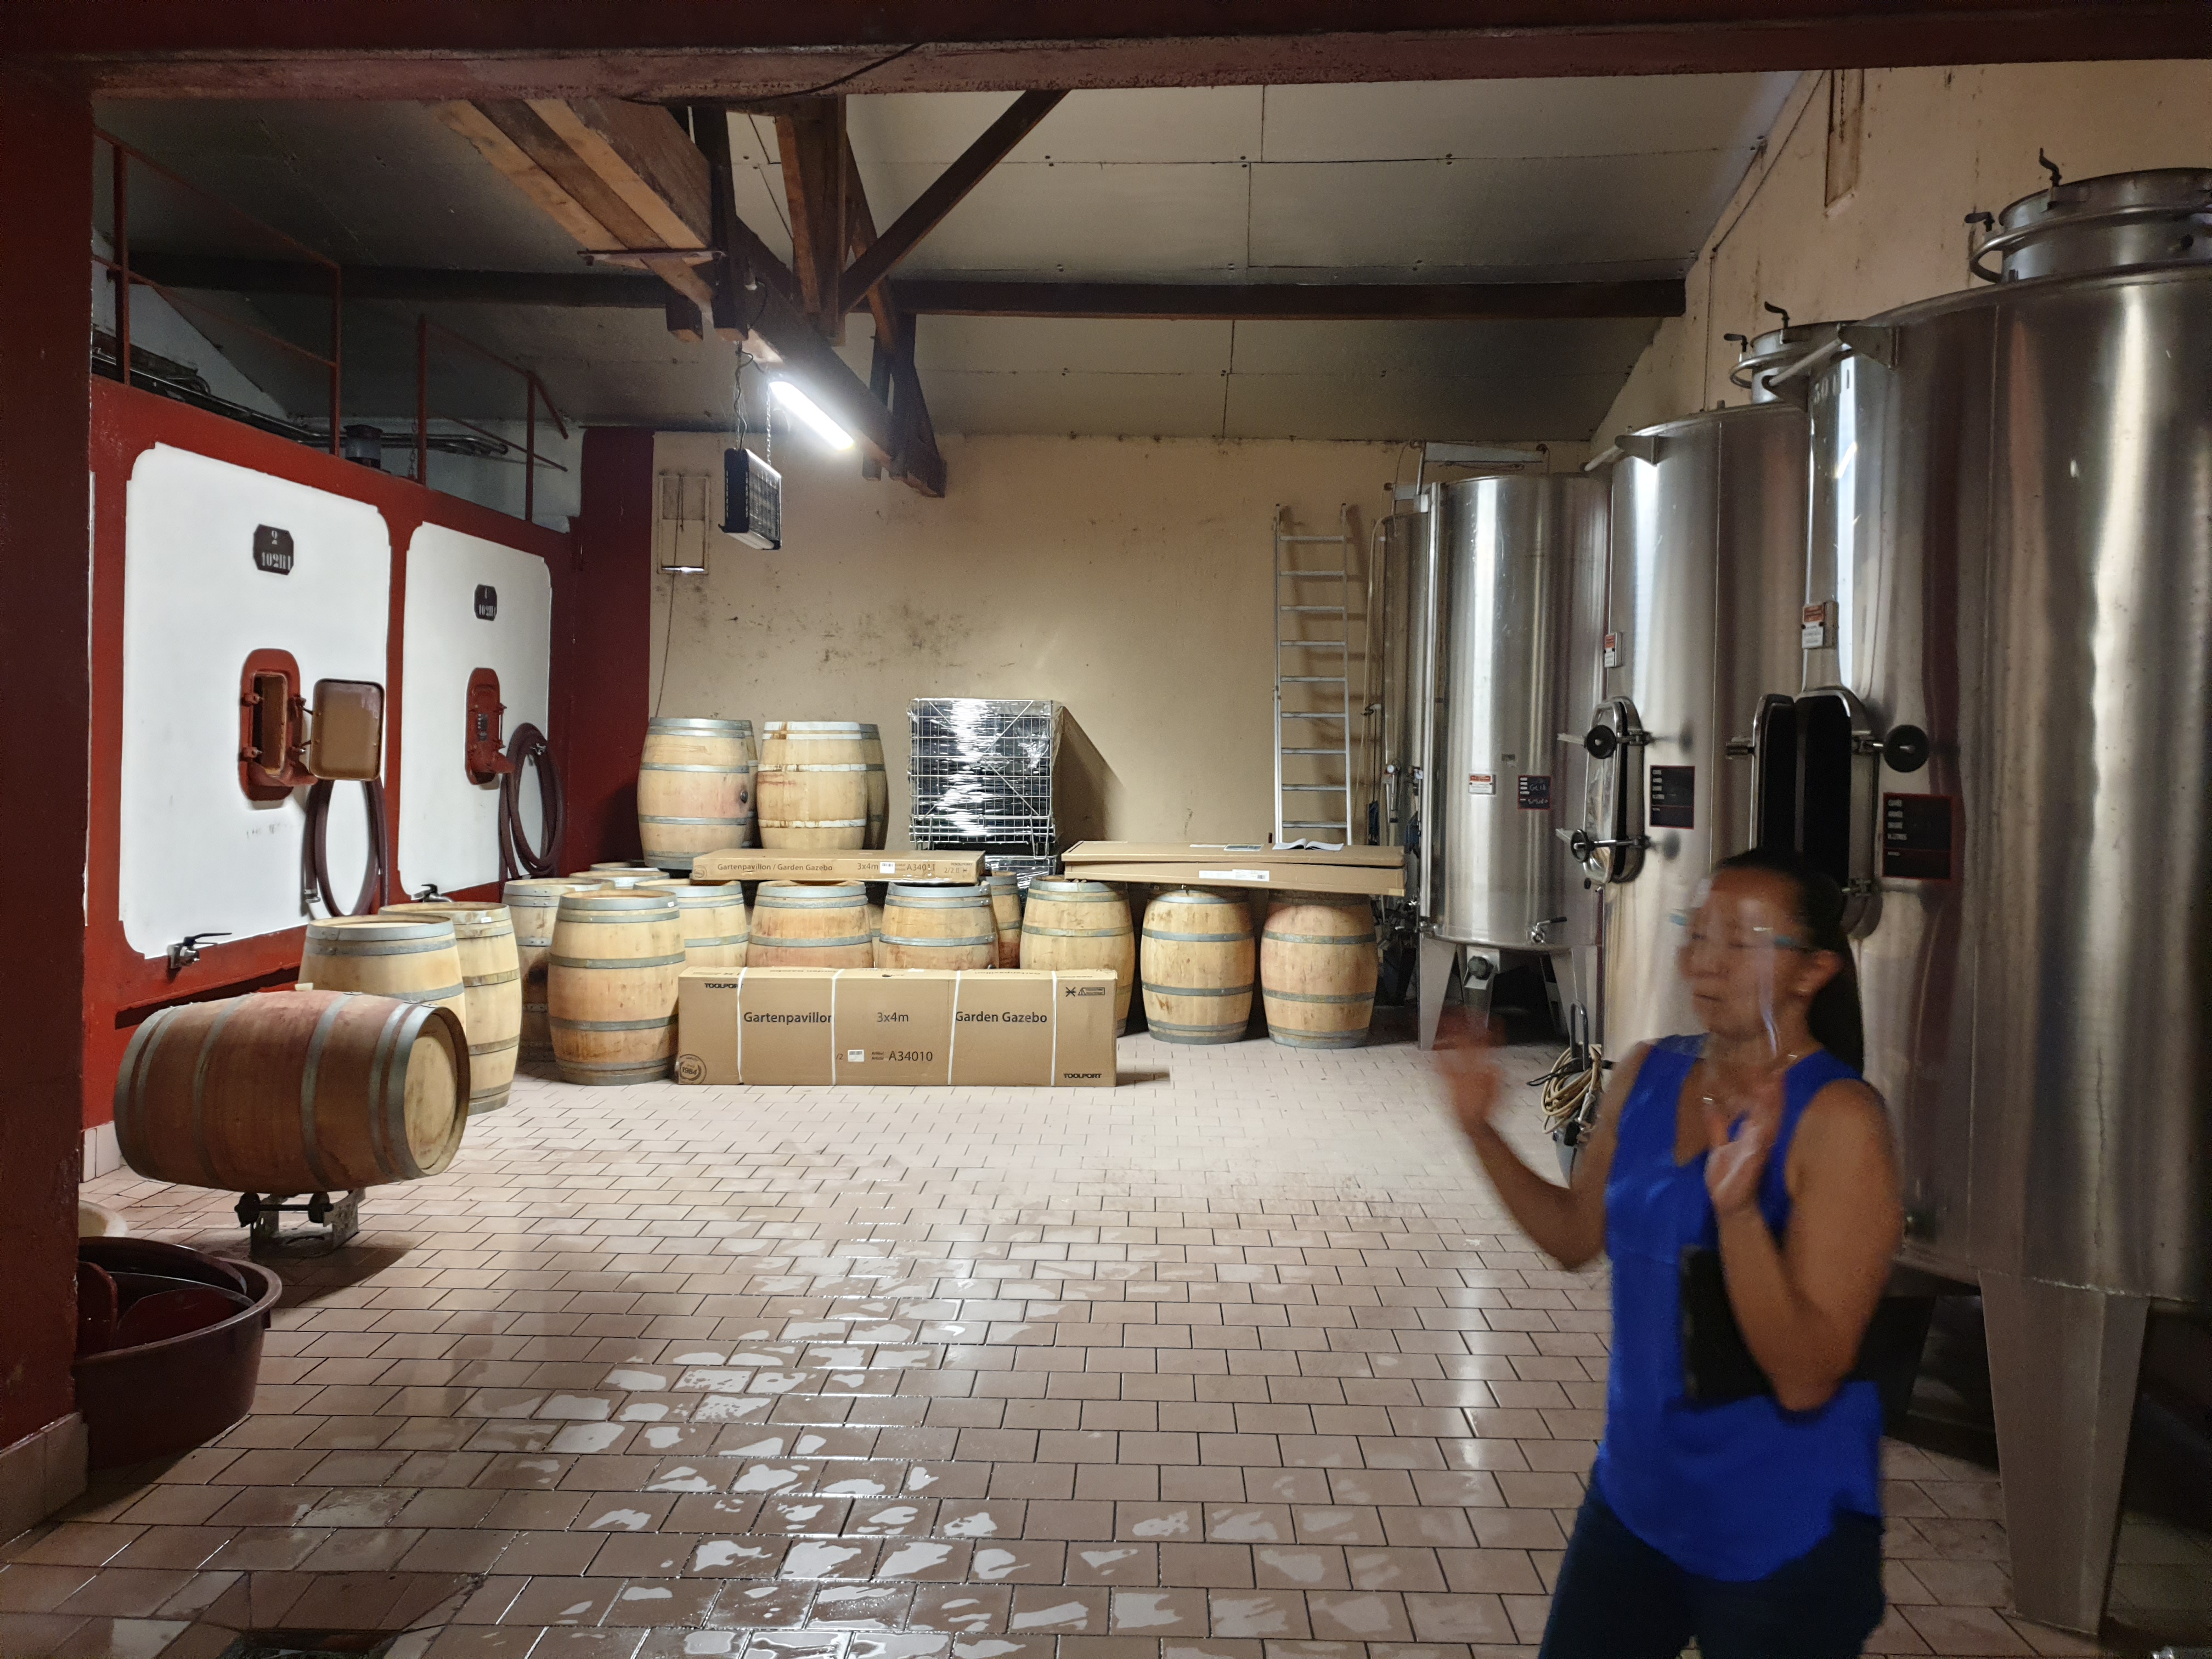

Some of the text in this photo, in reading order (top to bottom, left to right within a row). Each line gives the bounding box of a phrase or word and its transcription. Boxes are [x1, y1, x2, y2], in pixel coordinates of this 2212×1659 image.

[272, 530, 278, 545] 2
[877, 1012, 909, 1023] 3x4m
[956, 1011, 1047, 1023] Garden Gazebo
[889, 1051, 933, 1062] A34010
